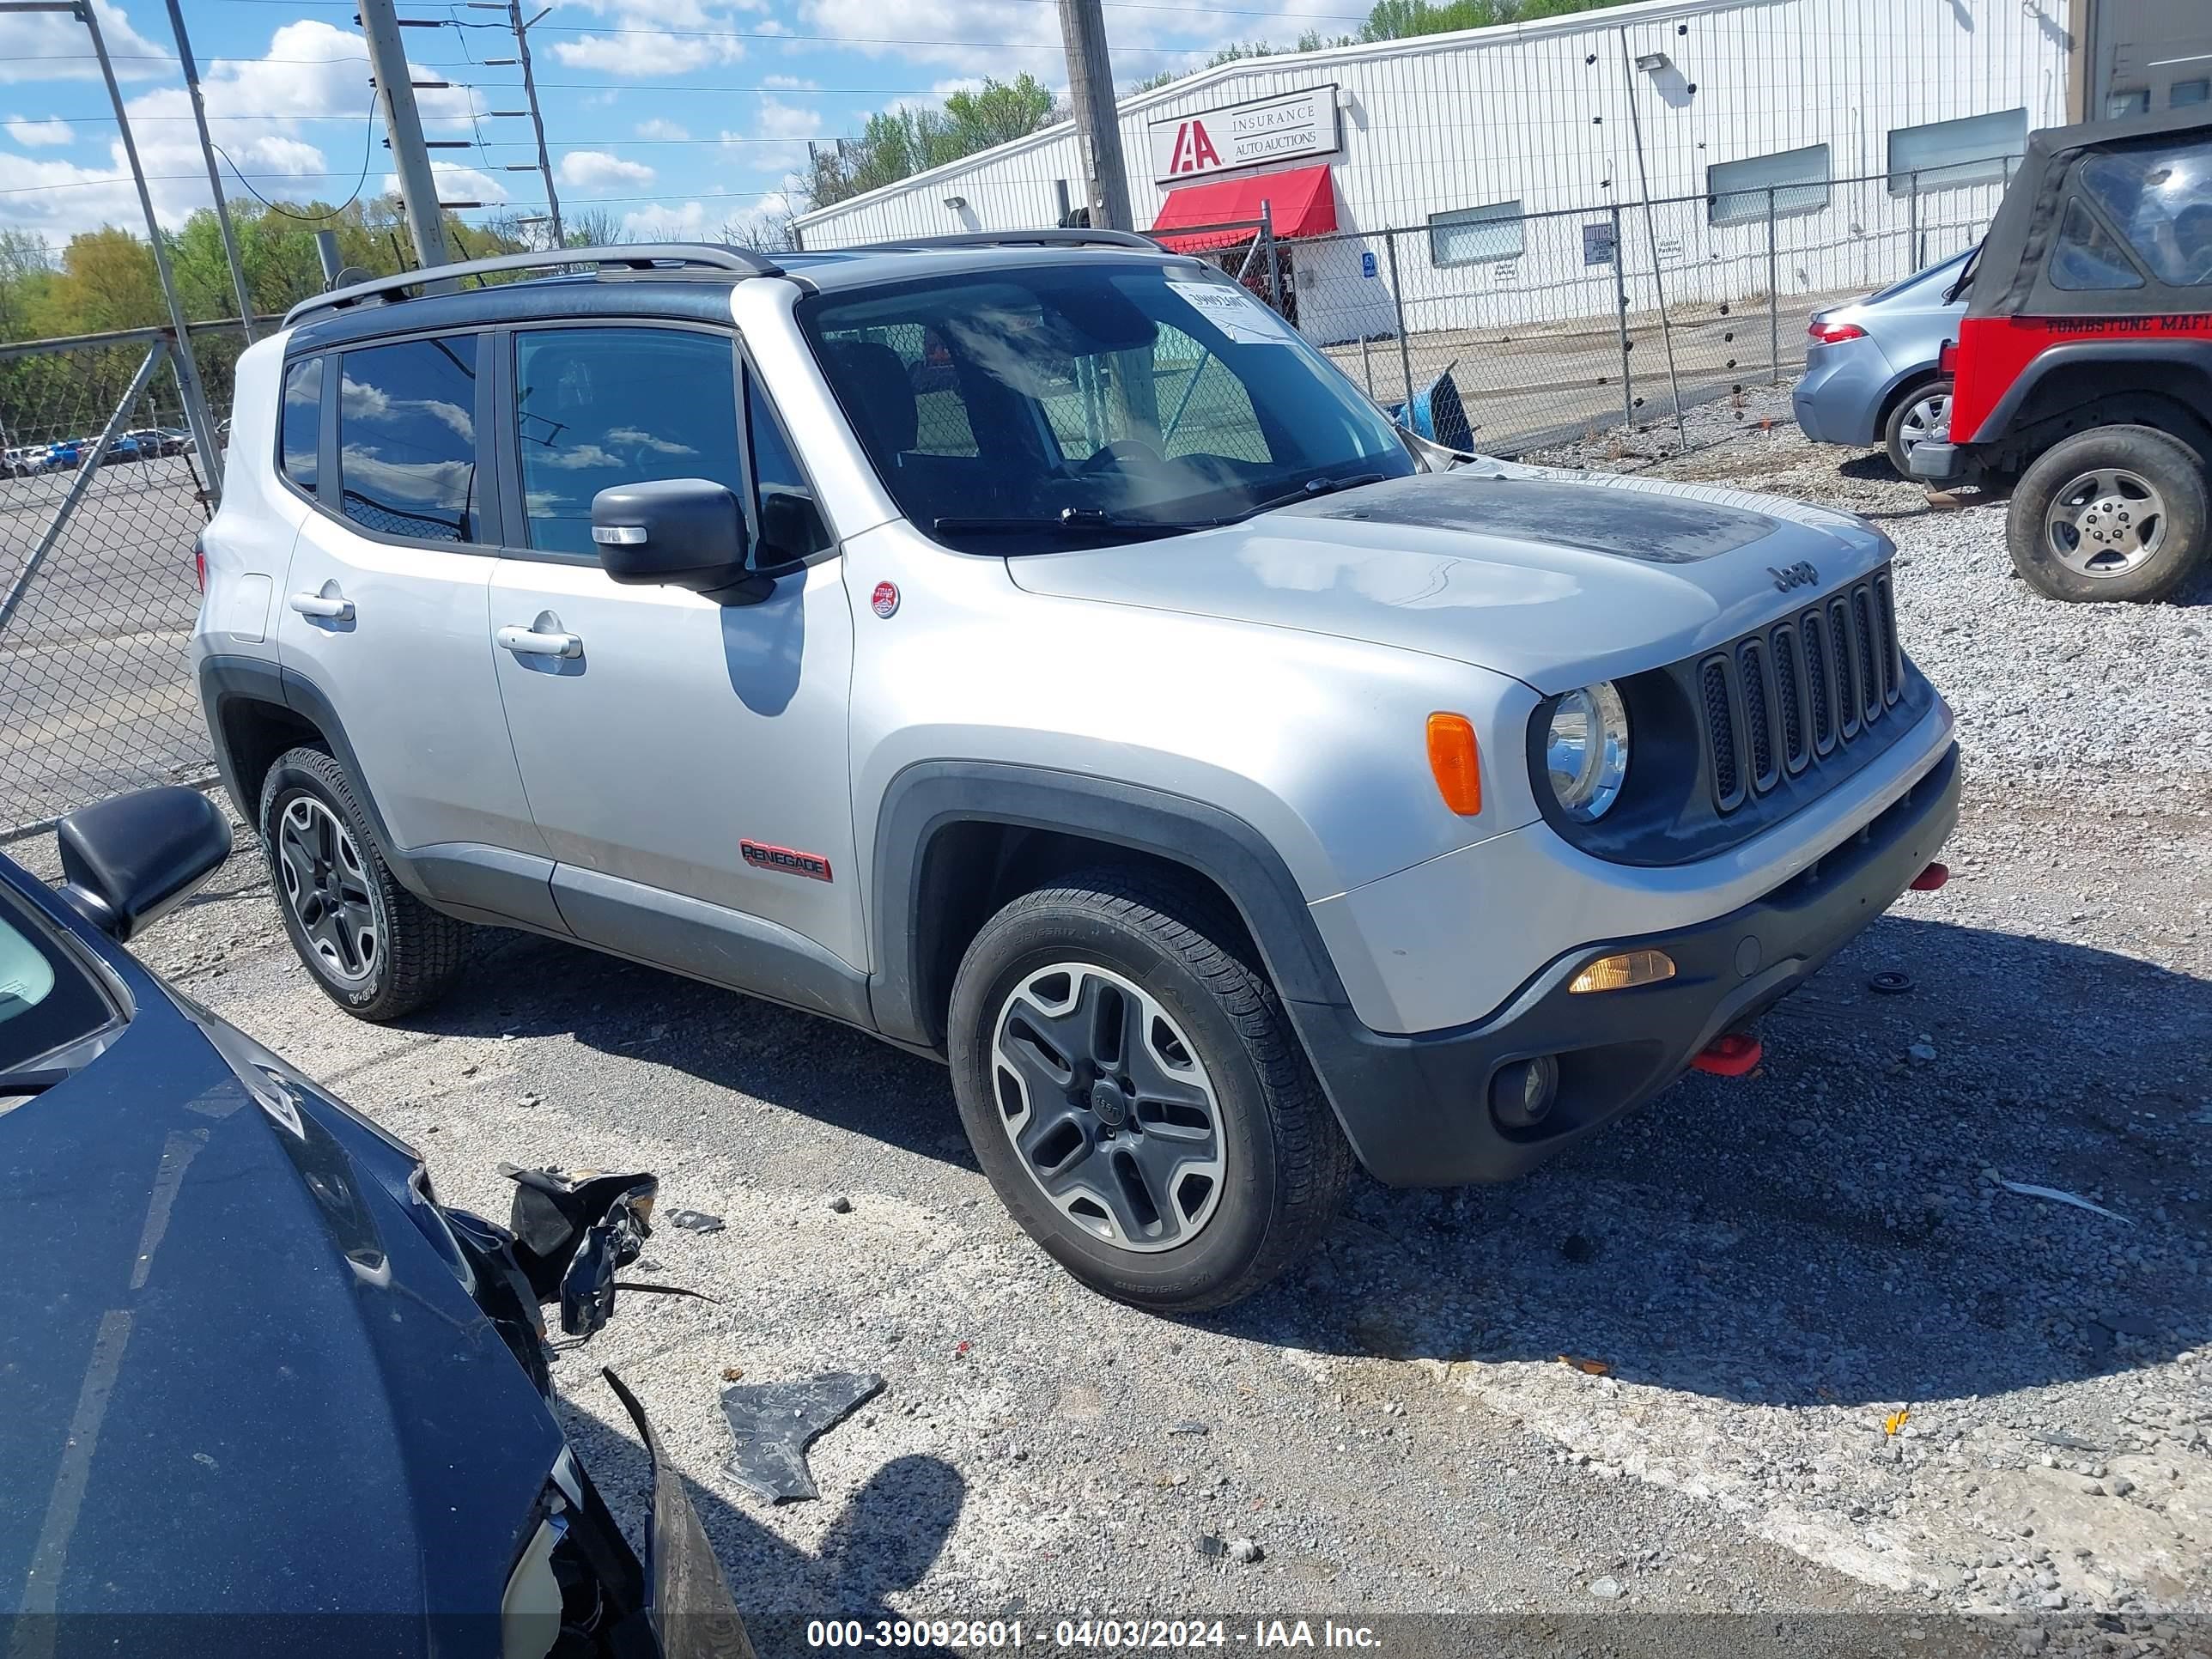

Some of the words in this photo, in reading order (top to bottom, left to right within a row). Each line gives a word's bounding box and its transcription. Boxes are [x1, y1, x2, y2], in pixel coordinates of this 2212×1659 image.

[1232, 105, 1316, 132] INSURANCE
[1235, 140, 1263, 157] AUTO
[1264, 131, 1316, 151] AUCTIONS
[1584, 225, 1612, 241] NOTICE
[2046, 316, 2152, 333] TOMBSTONE
[1766, 560, 1820, 593] Jeep
[740, 844, 825, 874] RENEGADE
